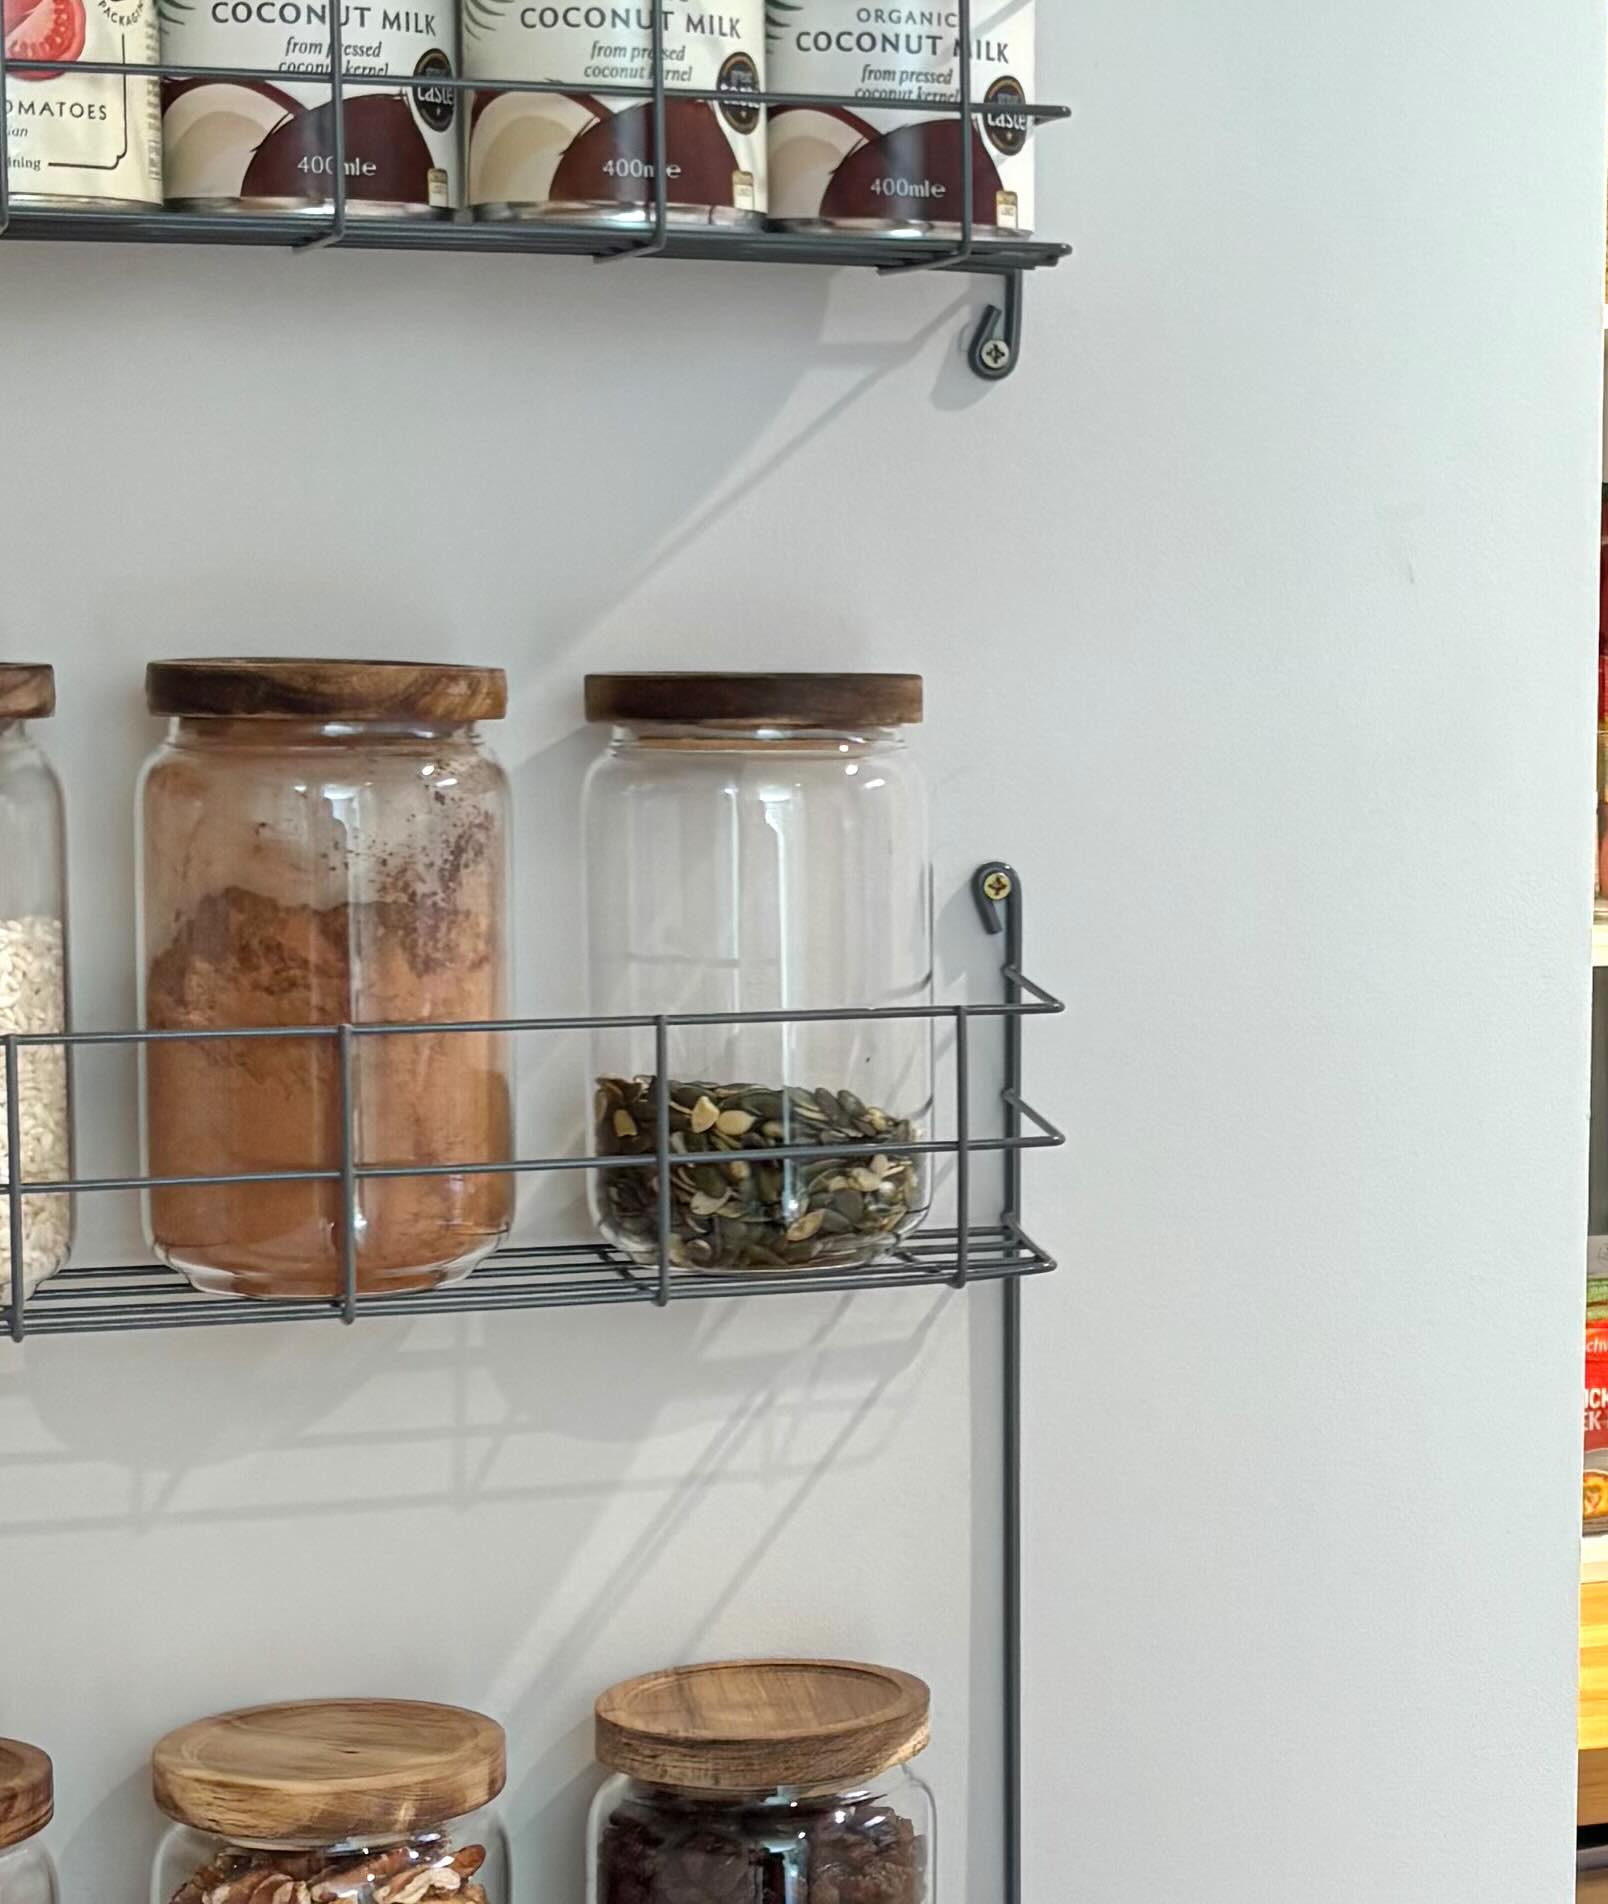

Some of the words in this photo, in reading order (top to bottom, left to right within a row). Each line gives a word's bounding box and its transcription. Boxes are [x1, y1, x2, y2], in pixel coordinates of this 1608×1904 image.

[382, 8, 437, 37] MILK
[520, 7, 675, 32] COCONUT
[685, 12, 742, 39] MILK
[856, 7, 960, 28] ORGANIC
[285, 36, 323, 57] from
[326, 40, 383, 62] essed
[590, 40, 627, 61] from
[630, 44, 687, 65] presed
[796, 31, 943, 57] COCONUT
[584, 64, 646, 81] coconut
[861, 63, 898, 83] from
[899, 68, 954, 87] pressed
